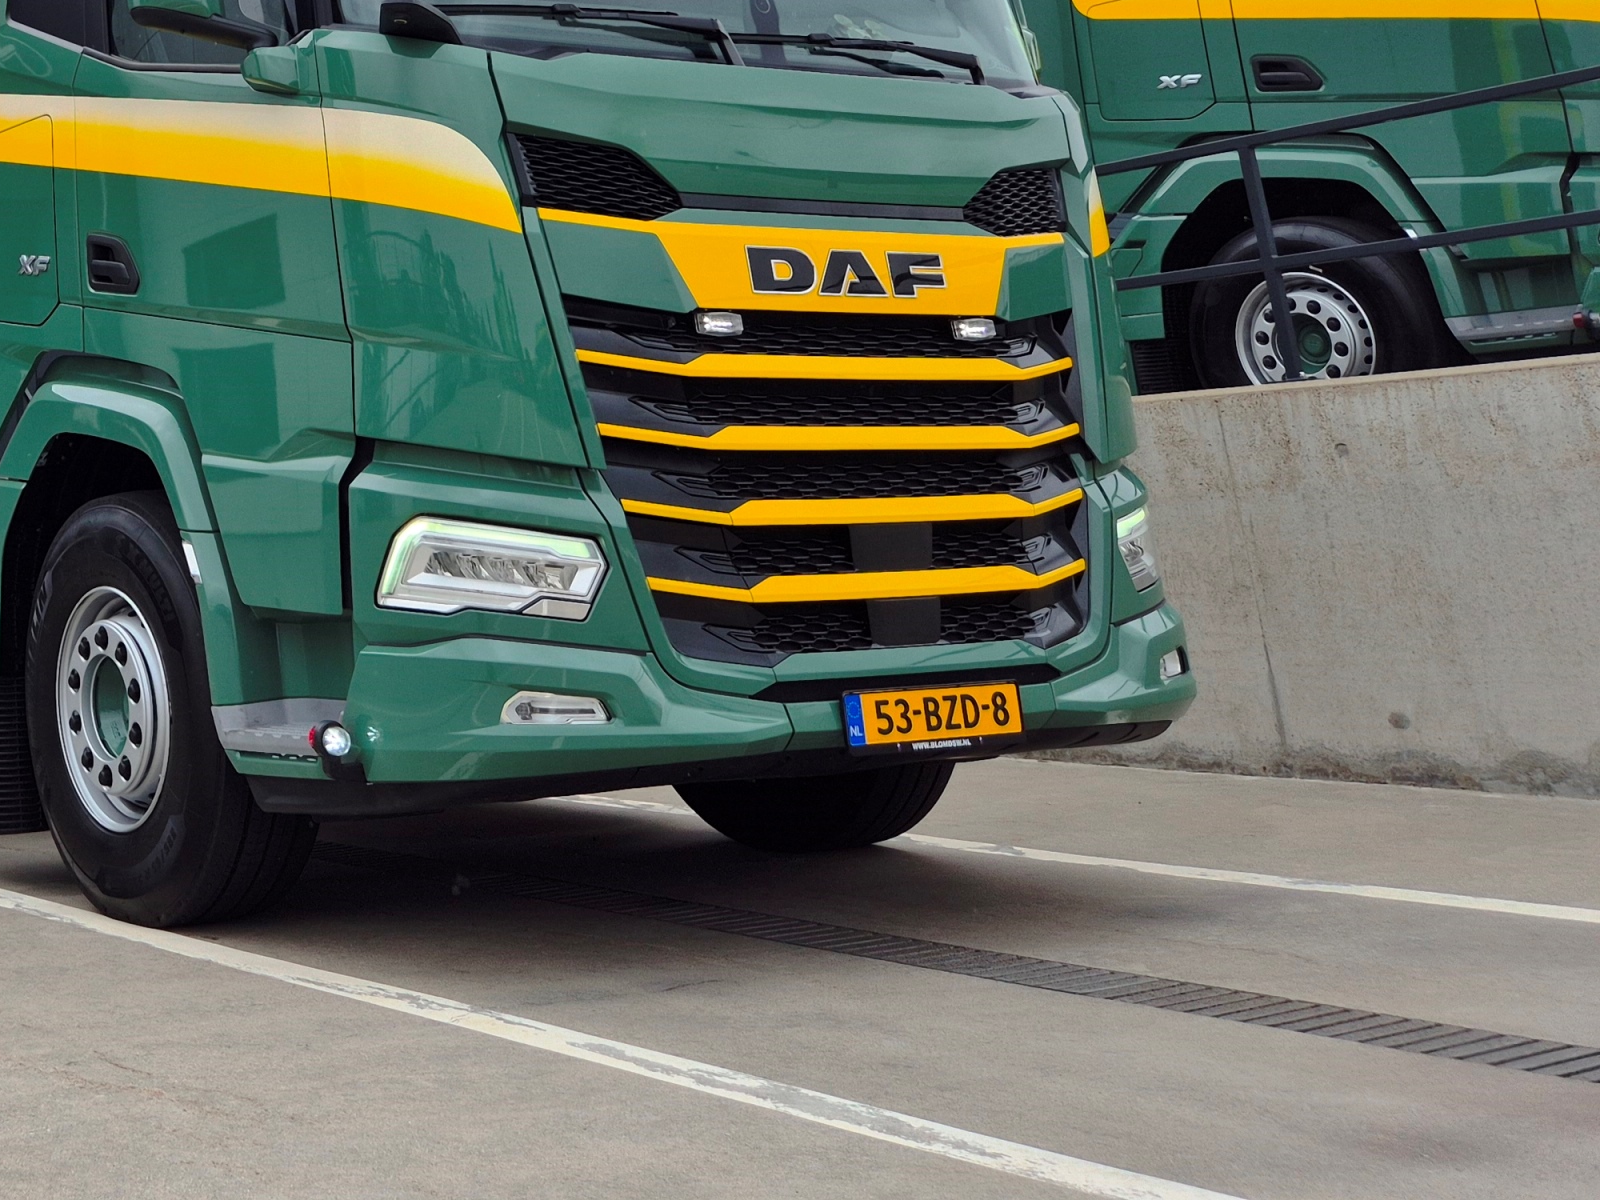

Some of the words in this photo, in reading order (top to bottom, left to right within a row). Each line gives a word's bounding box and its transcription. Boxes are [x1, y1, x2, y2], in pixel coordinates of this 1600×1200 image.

[1156, 73, 1203, 89] XF
[17, 254, 51, 276] XF
[744, 244, 948, 299] DAF
[874, 690, 1011, 736] 53-BZD-8
[849, 725, 864, 738] NL
